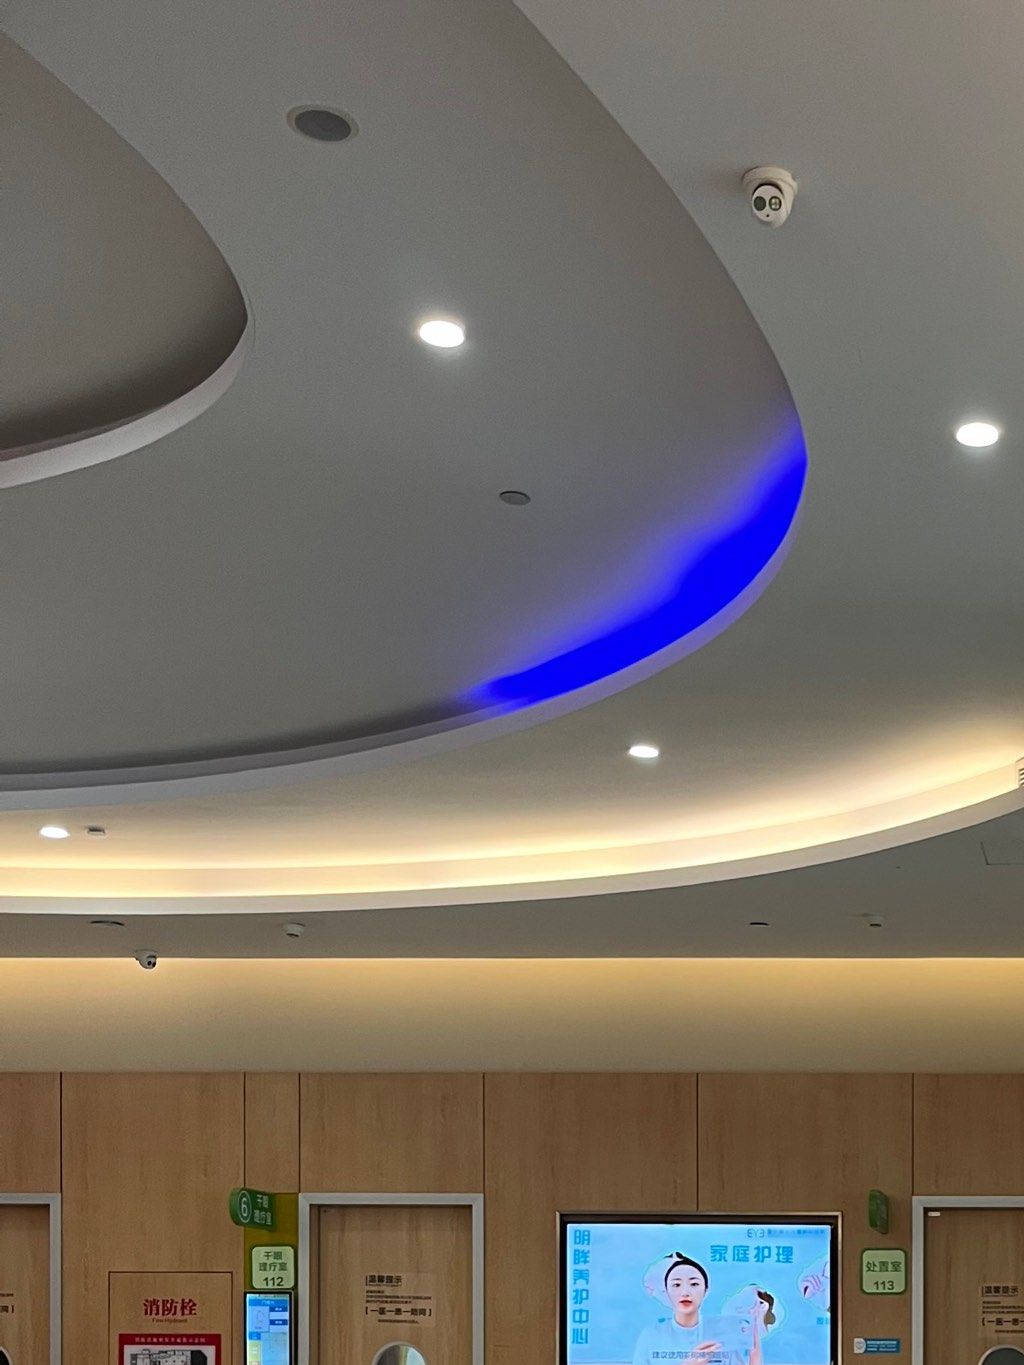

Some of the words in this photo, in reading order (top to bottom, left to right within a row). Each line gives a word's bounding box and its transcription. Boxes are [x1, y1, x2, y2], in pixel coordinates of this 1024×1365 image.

[241, 1197, 248, 1217] 6
[264, 1251, 283, 1261] 干眼
[709, 1245, 794, 1264] 家庭护理
[258, 1262, 288, 1271] 理疗室
[865, 1261, 902, 1272] 处置室
[262, 1277, 284, 1287] 112
[571, 1229, 591, 1344] 明眸养护中心
[873, 1280, 895, 1291] 113
[143, 1298, 198, 1316] 消防栓
